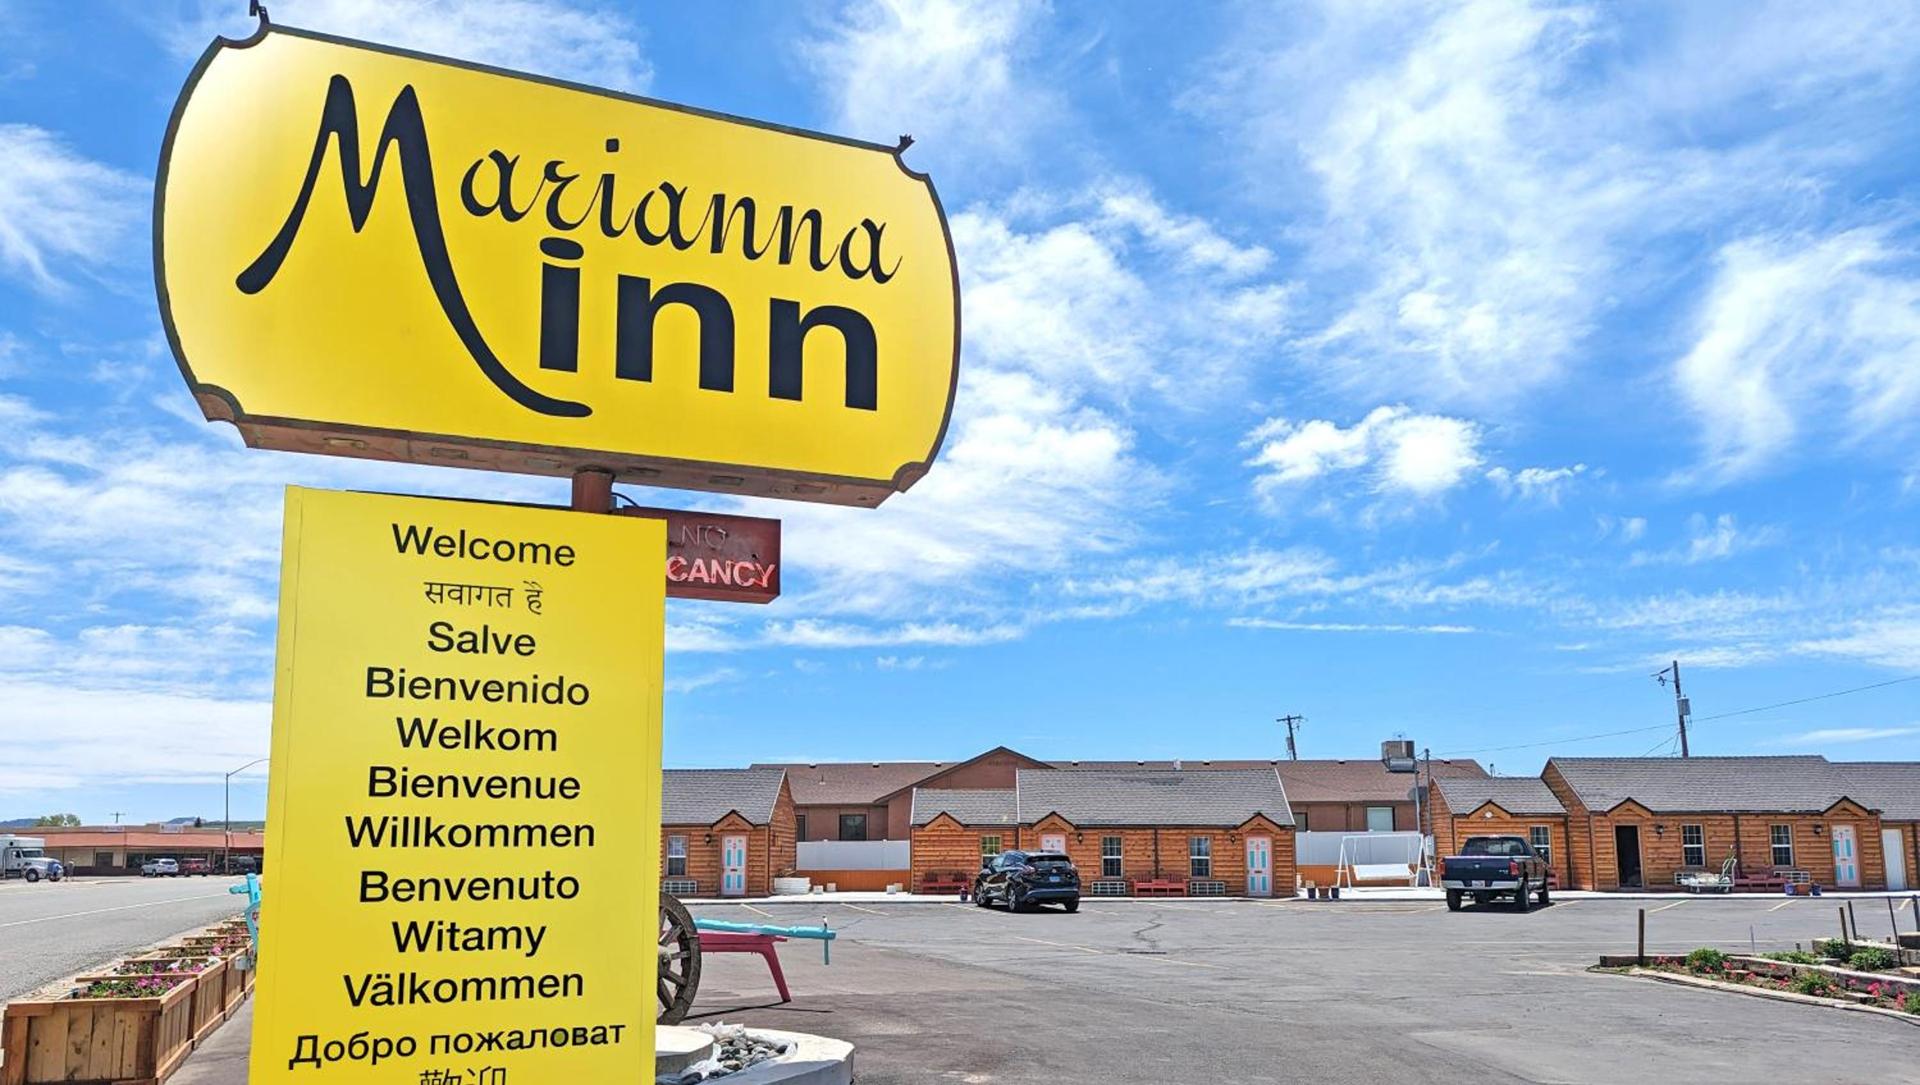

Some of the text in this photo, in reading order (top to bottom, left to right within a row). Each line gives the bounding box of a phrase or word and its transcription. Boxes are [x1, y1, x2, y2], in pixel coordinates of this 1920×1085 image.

[236, 73, 903, 418] Marianna
[538, 236, 878, 411] inn
[391, 523, 576, 567] Welcome
[681, 525, 727, 549] NO
[667, 555, 775, 588] CANCY
[427, 621, 537, 657] Salve
[366, 666, 590, 706] Bienvenido
[396, 717, 557, 752] Welkom
[368, 766, 581, 800] Bienvenue
[345, 815, 595, 848] Willkommen
[359, 870, 580, 903] Benvenuto
[391, 920, 547, 958] Witamy
[343, 972, 584, 1007] Välkommen
[288, 1022, 626, 1071] Добро пожаловат
